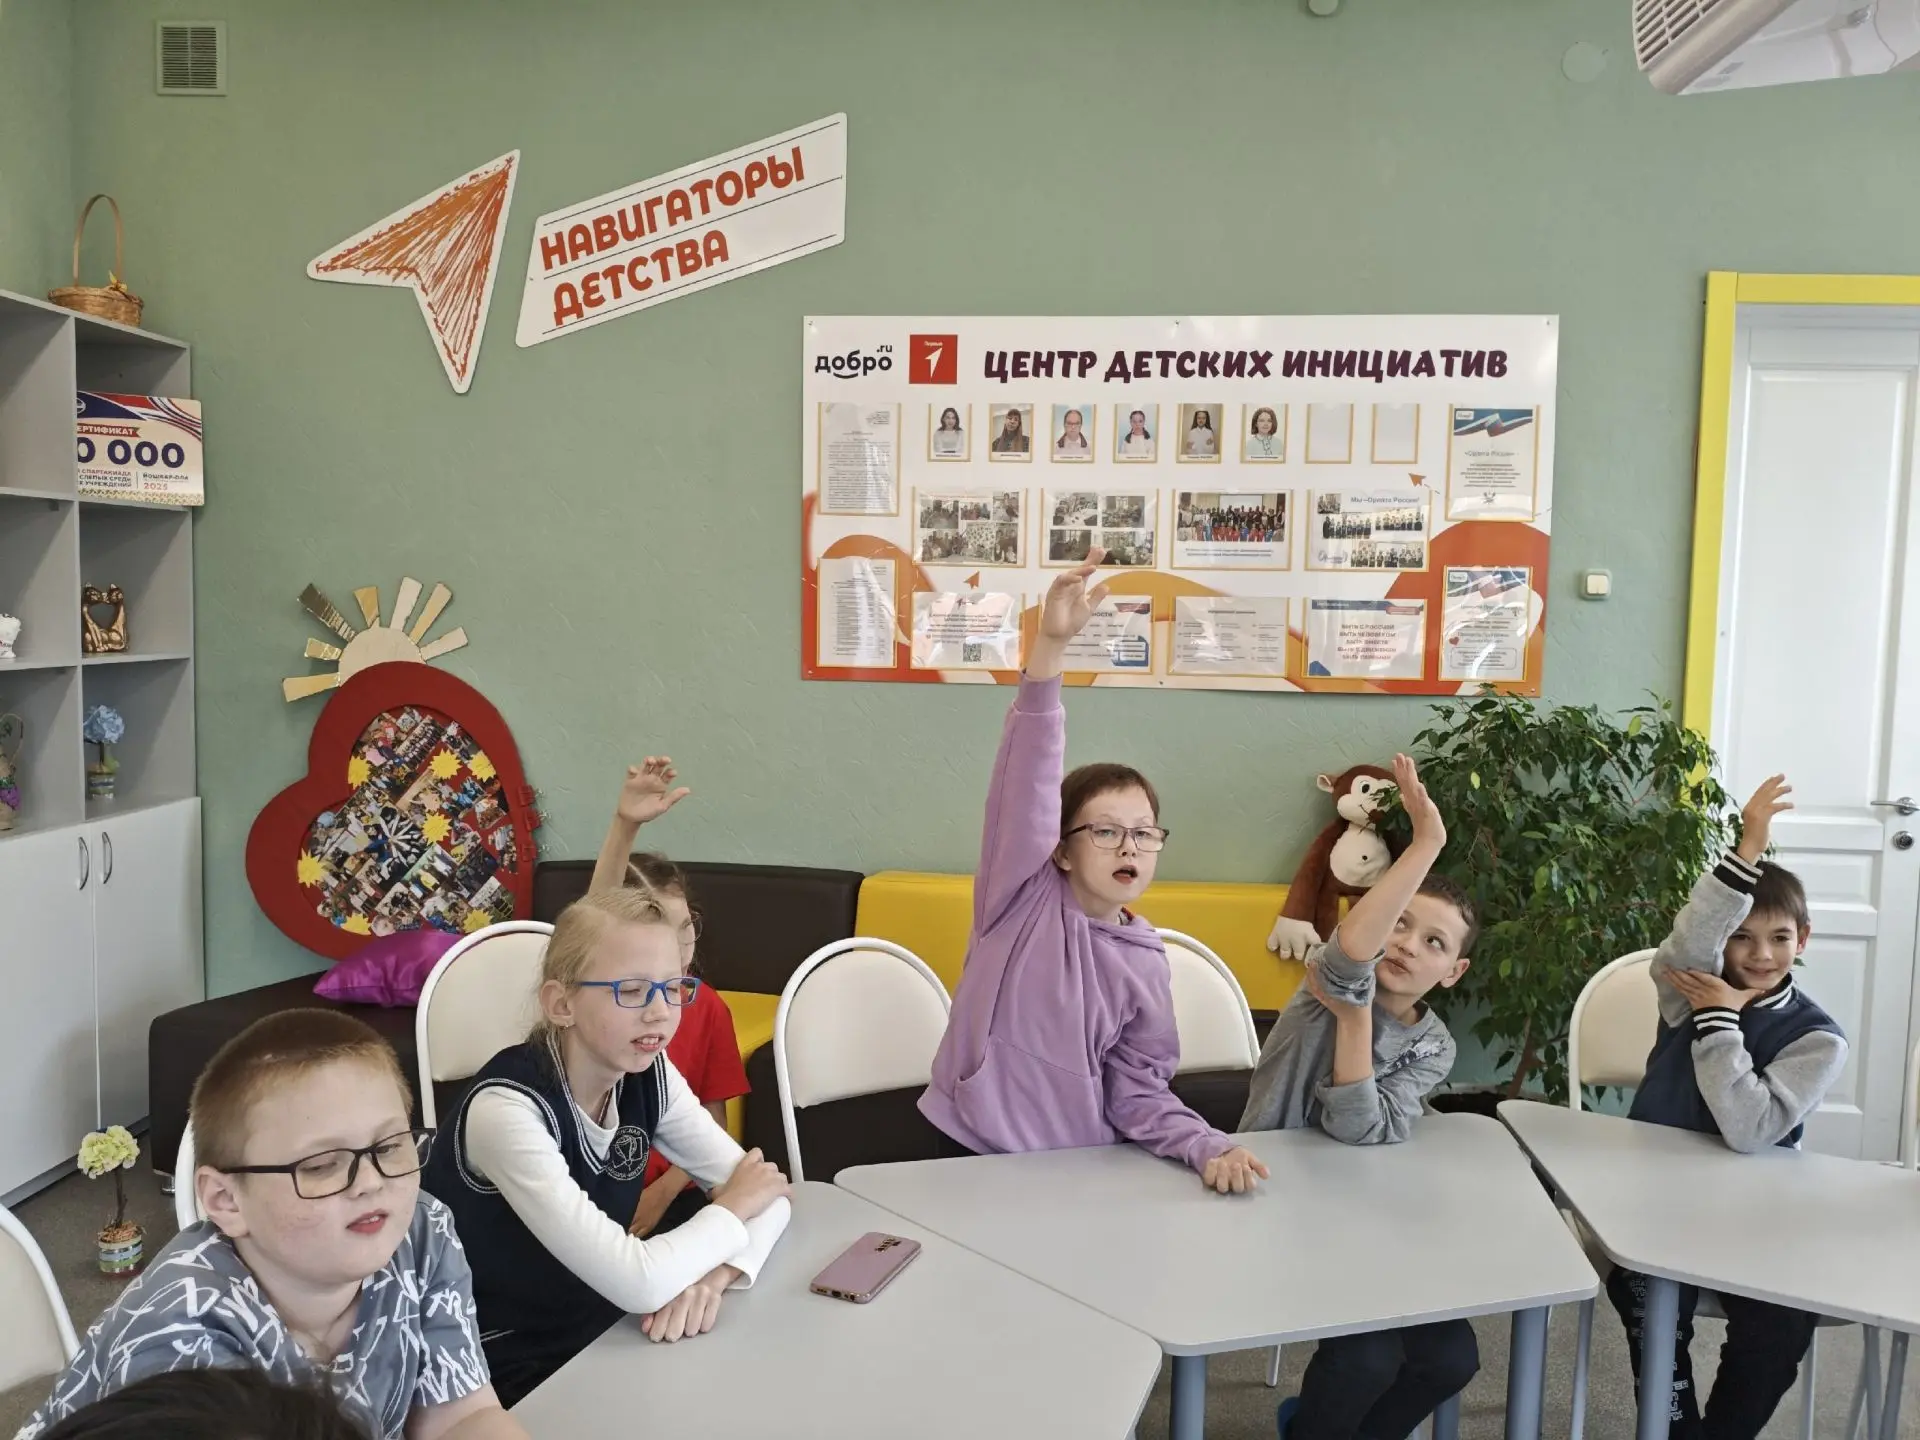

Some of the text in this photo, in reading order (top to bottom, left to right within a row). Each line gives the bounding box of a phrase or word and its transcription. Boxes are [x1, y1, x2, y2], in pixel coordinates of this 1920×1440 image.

[539, 146, 805, 271] НАВИГАТОРЫ
[553, 229, 730, 327] ДЕТСТВА
[876, 345, 893, 353] .ru
[815, 350, 893, 377] добро
[984, 349, 1509, 384] ЦЕНТР ДЕТСКИХ ИНИЦИАТИВ
[77, 425, 134, 436] ЕРТИФИКАТ
[107, 439, 185, 468] 000
[82, 468, 132, 476] СПАРТАКИАДА
[143, 482, 168, 490] 2025
